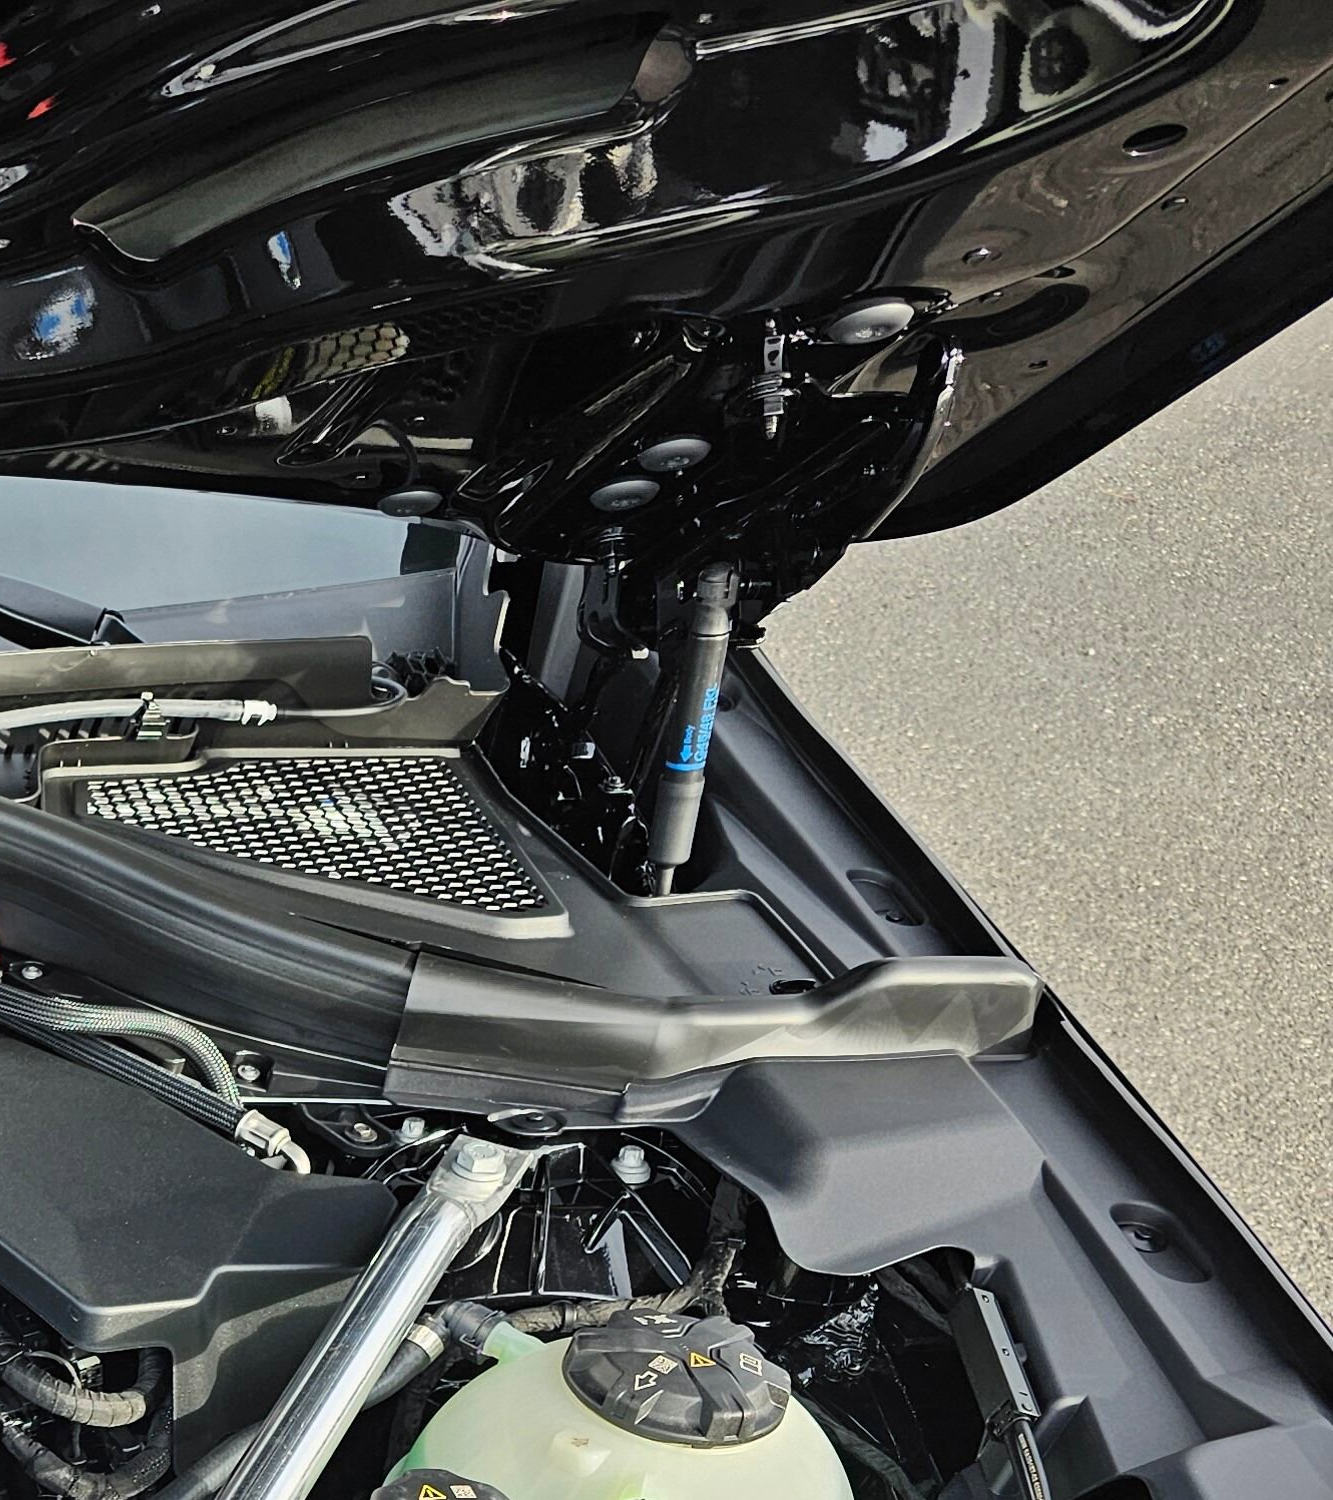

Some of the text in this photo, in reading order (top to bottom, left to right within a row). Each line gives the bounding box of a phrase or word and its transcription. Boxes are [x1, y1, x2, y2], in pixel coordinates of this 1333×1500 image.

[683, 724, 696, 743] Body
[694, 683, 719, 761] G45/48 FKL
